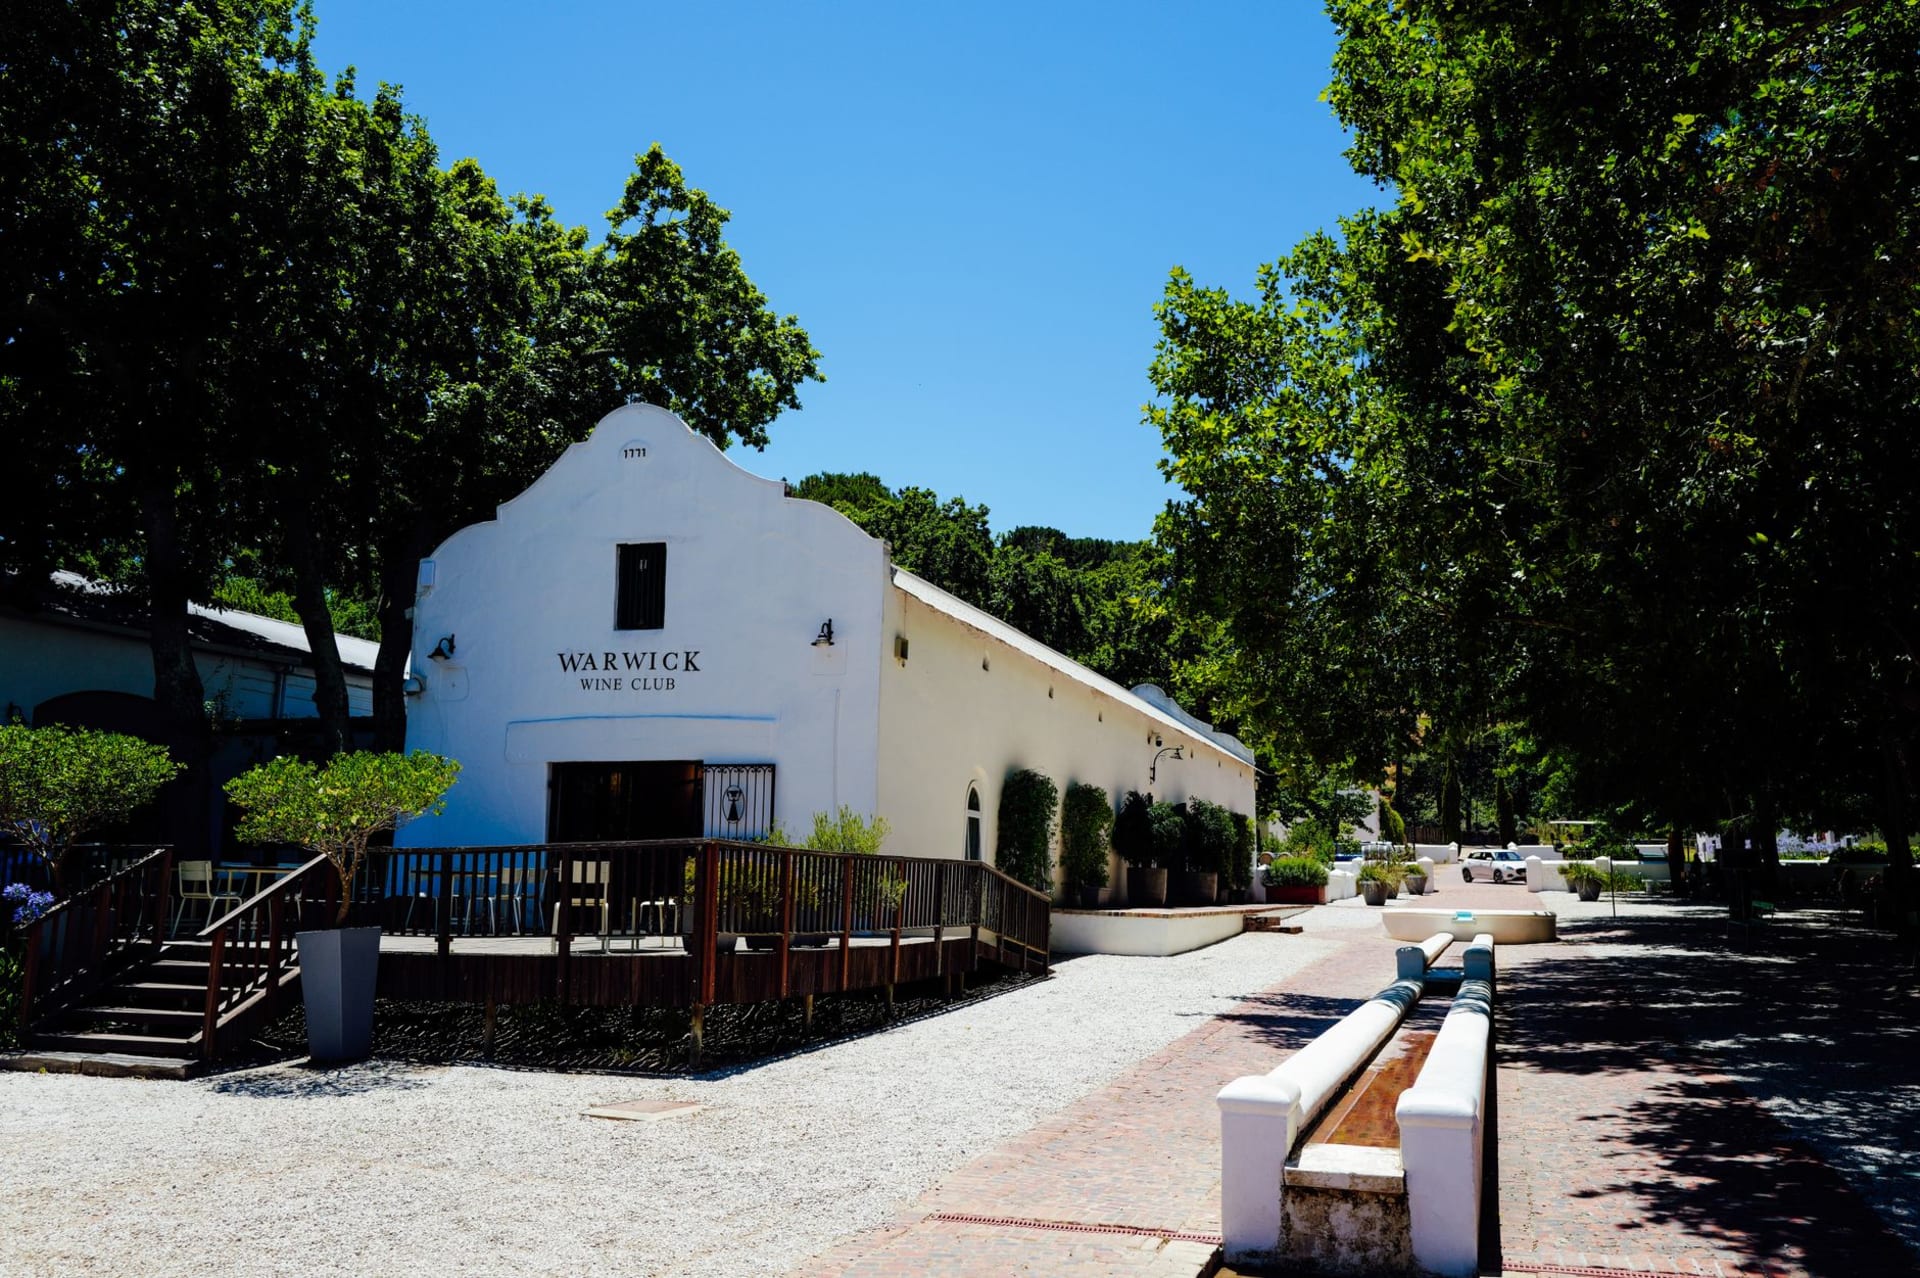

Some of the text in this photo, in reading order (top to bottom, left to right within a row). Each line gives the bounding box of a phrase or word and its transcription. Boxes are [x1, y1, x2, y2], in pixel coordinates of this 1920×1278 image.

[557, 651, 701, 672] WARWICK
[580, 677, 676, 691] WINE CLUB
